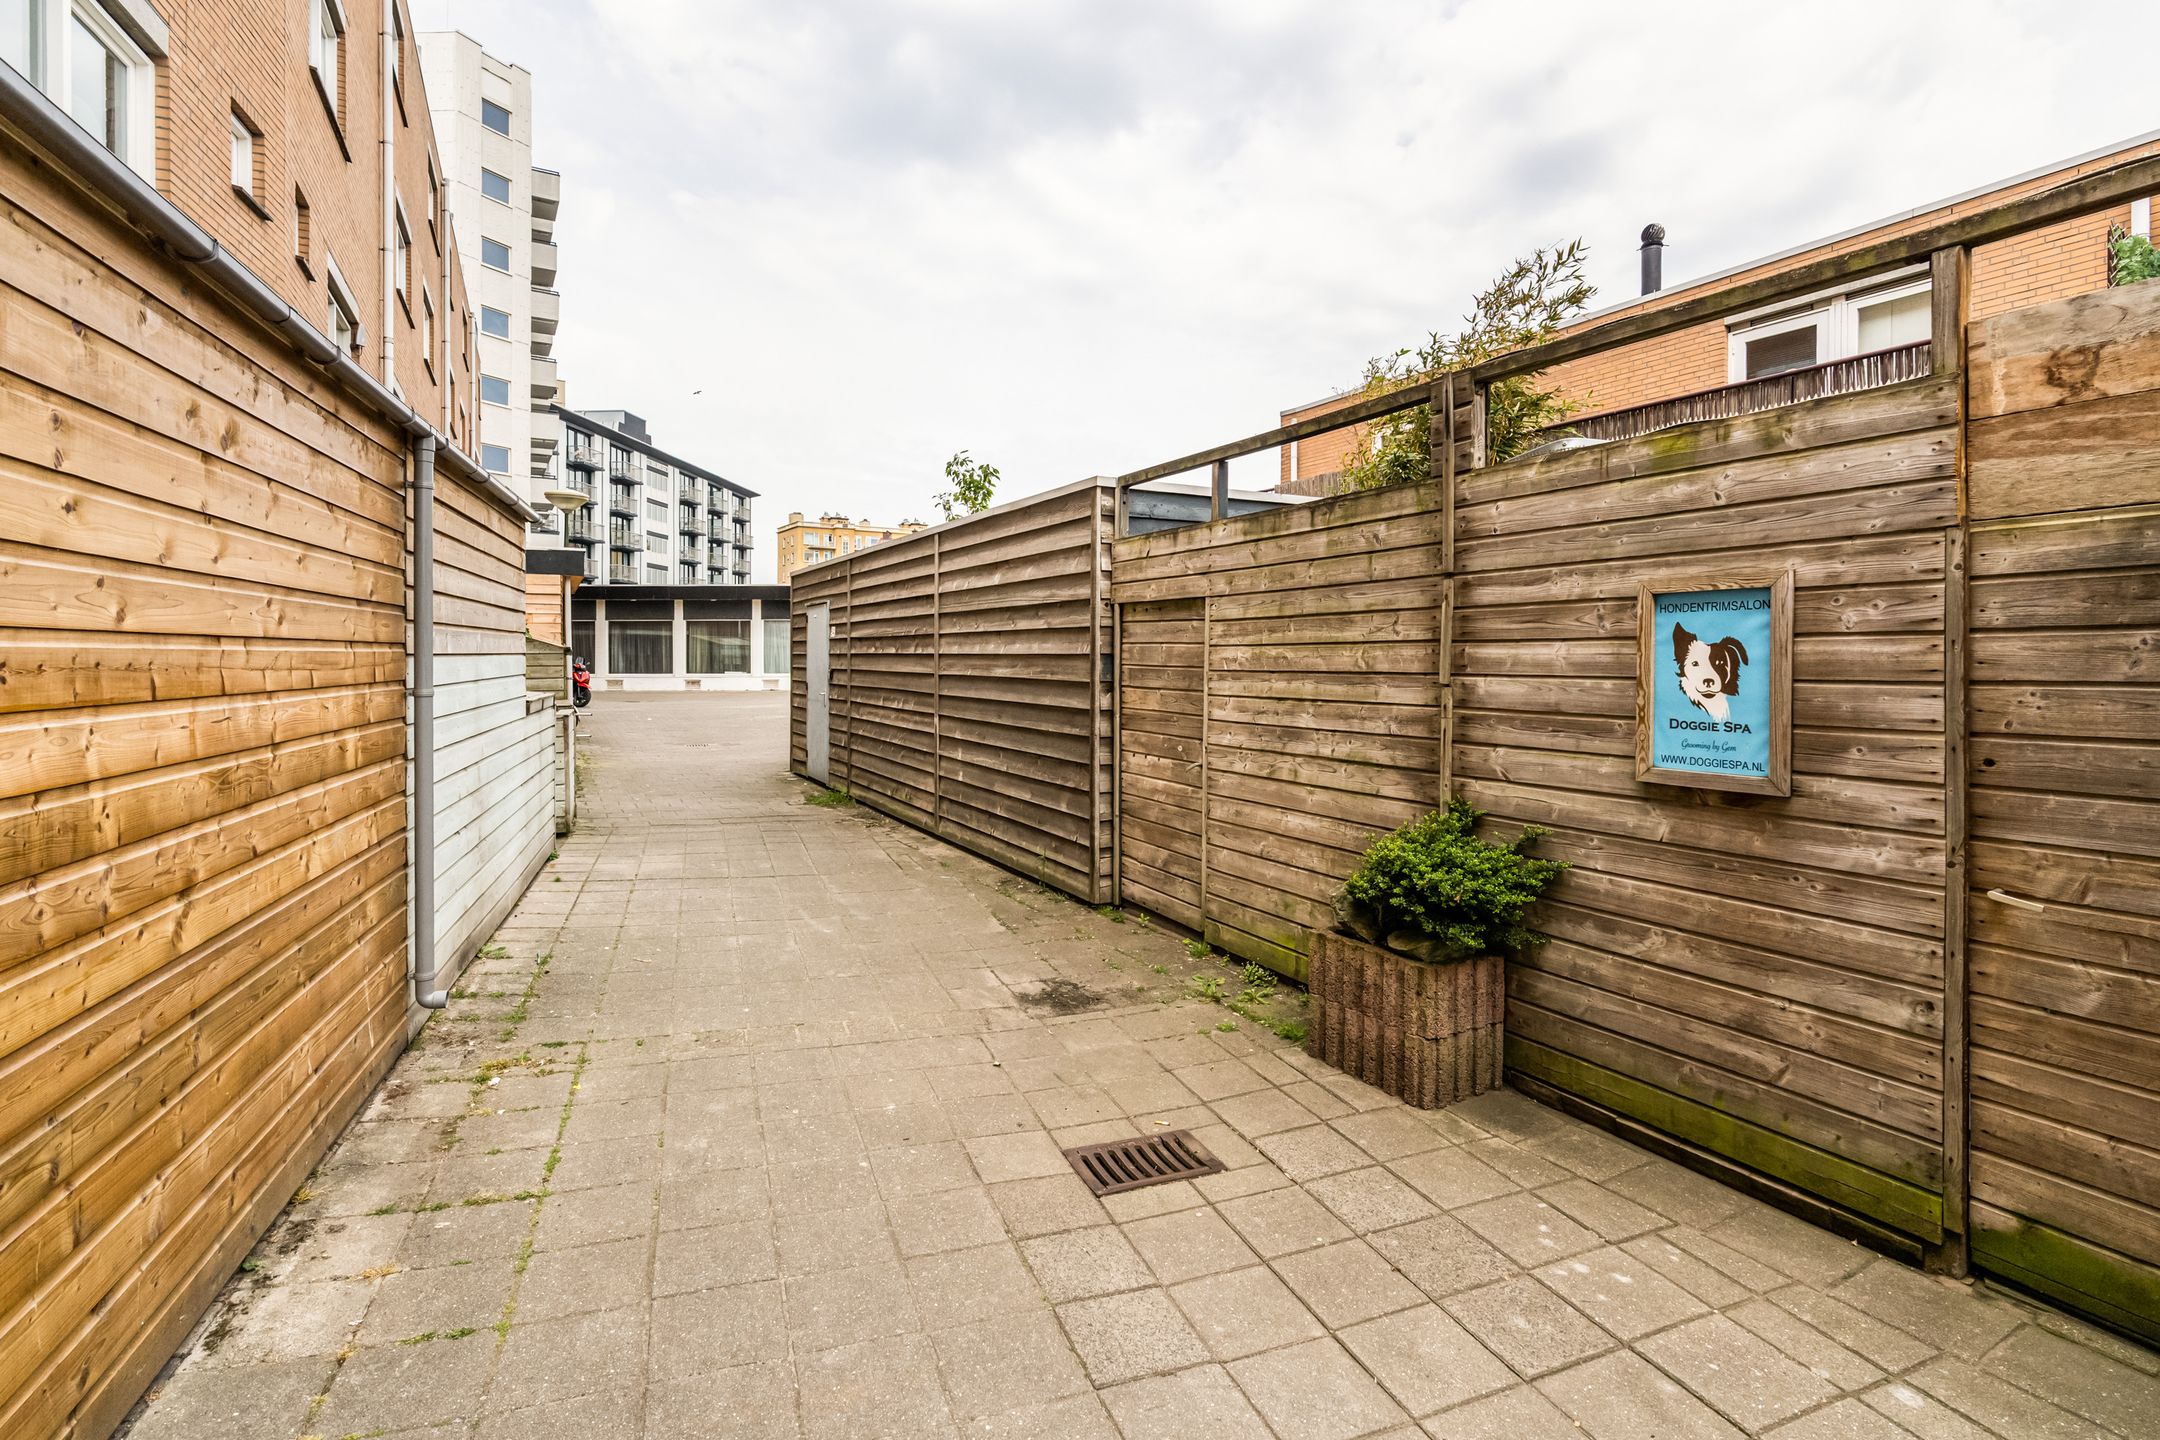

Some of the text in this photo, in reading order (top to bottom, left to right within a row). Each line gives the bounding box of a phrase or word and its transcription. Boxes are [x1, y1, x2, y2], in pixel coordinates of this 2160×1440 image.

[1659, 599, 1770, 613] HONDENTRIMSALON
[1723, 721, 1752, 734] SPA
[1681, 738, 1737, 752] Grooming by Gem
[1661, 754, 1765, 772] WWW.DOGGIESPA.NL
